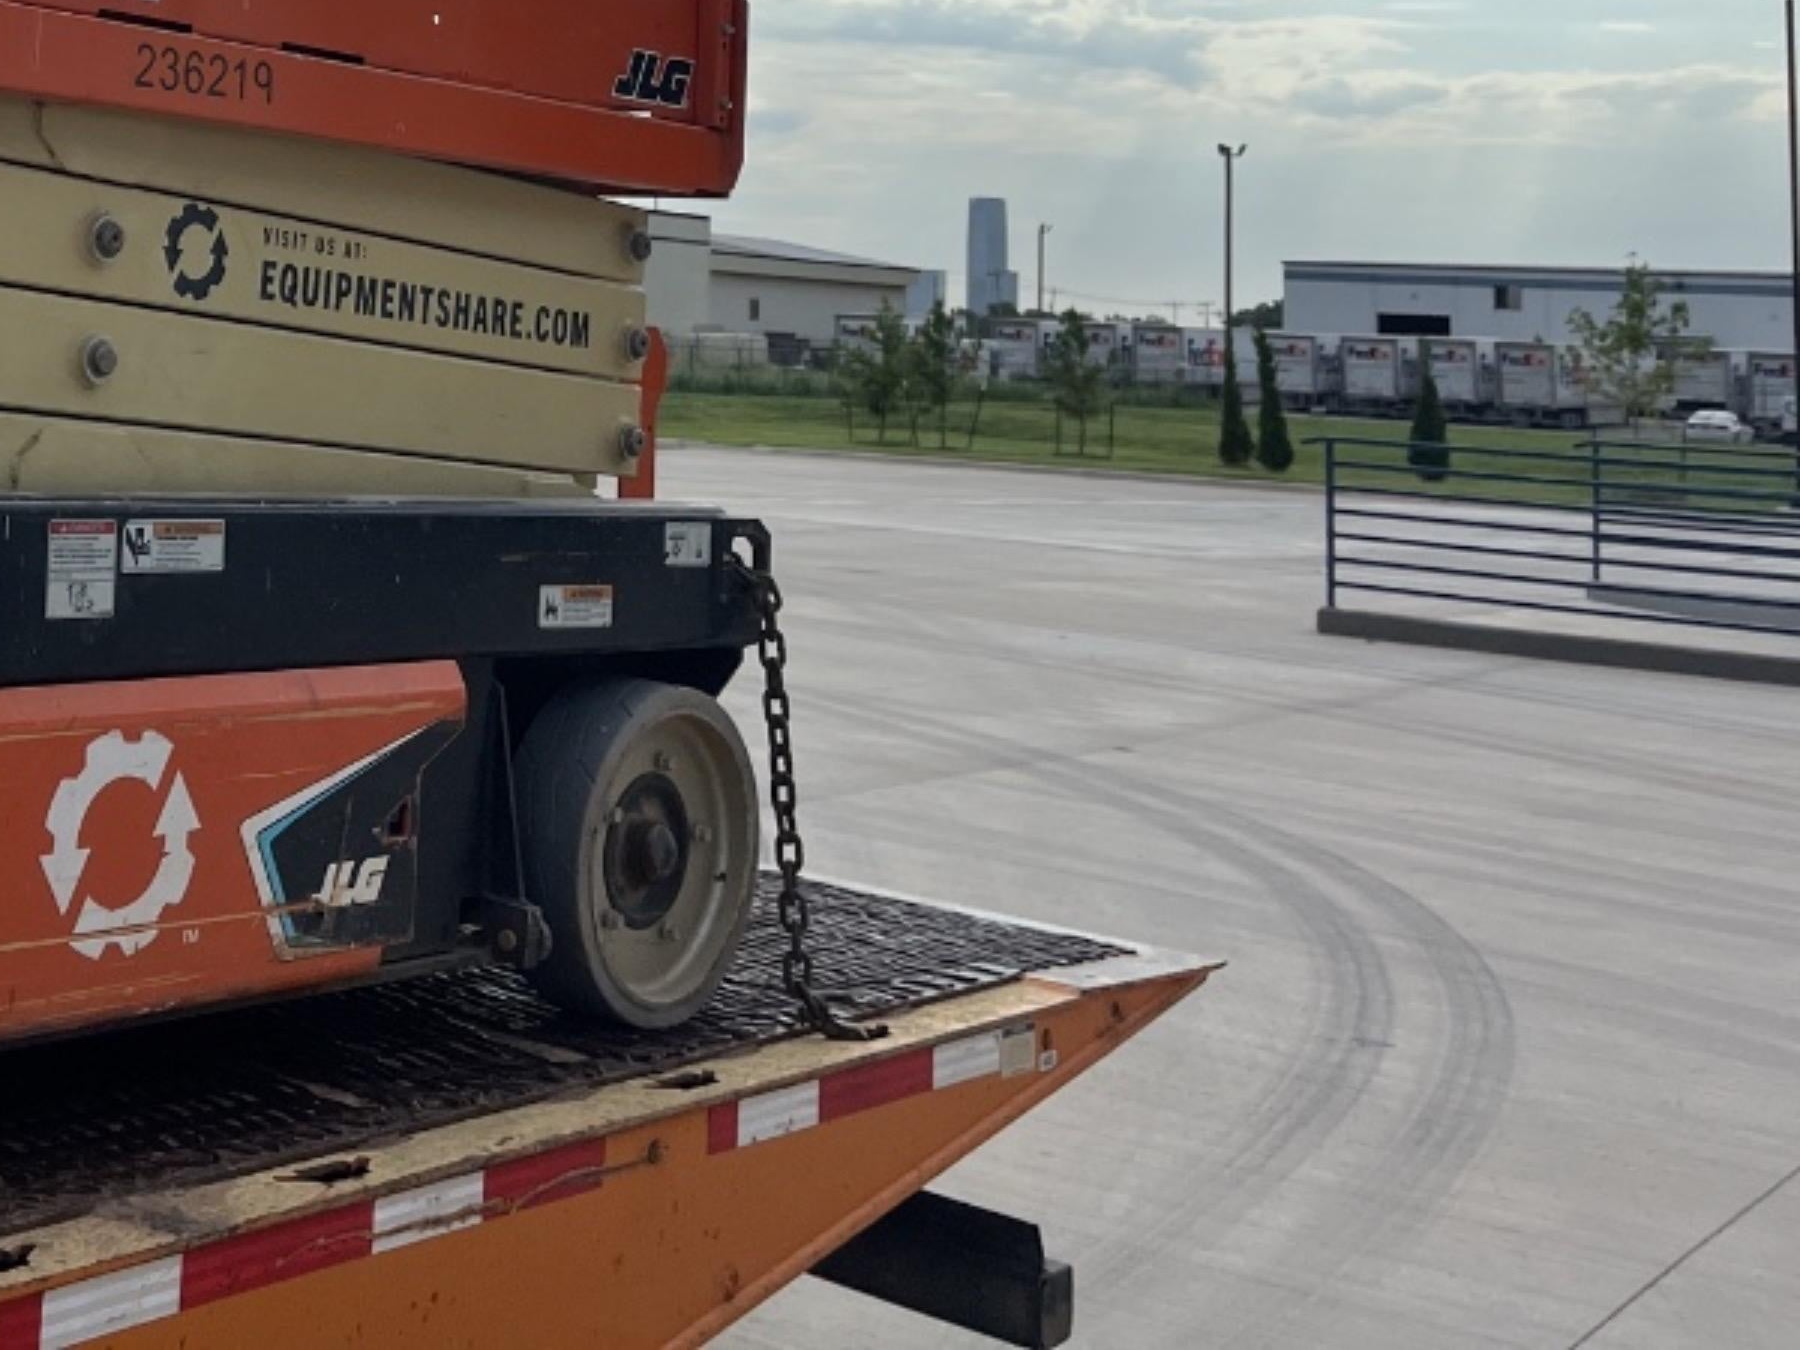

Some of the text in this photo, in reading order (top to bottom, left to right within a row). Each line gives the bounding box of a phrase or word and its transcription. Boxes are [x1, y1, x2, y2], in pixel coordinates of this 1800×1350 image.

[135, 43, 274, 104] 236219
[612, 49, 694, 109] JLG
[263, 226, 307, 250] VISIT
[315, 236, 336, 256] US
[259, 260, 590, 348] EQUIPMENTSHARE.COM
[311, 854, 391, 906] JLG
